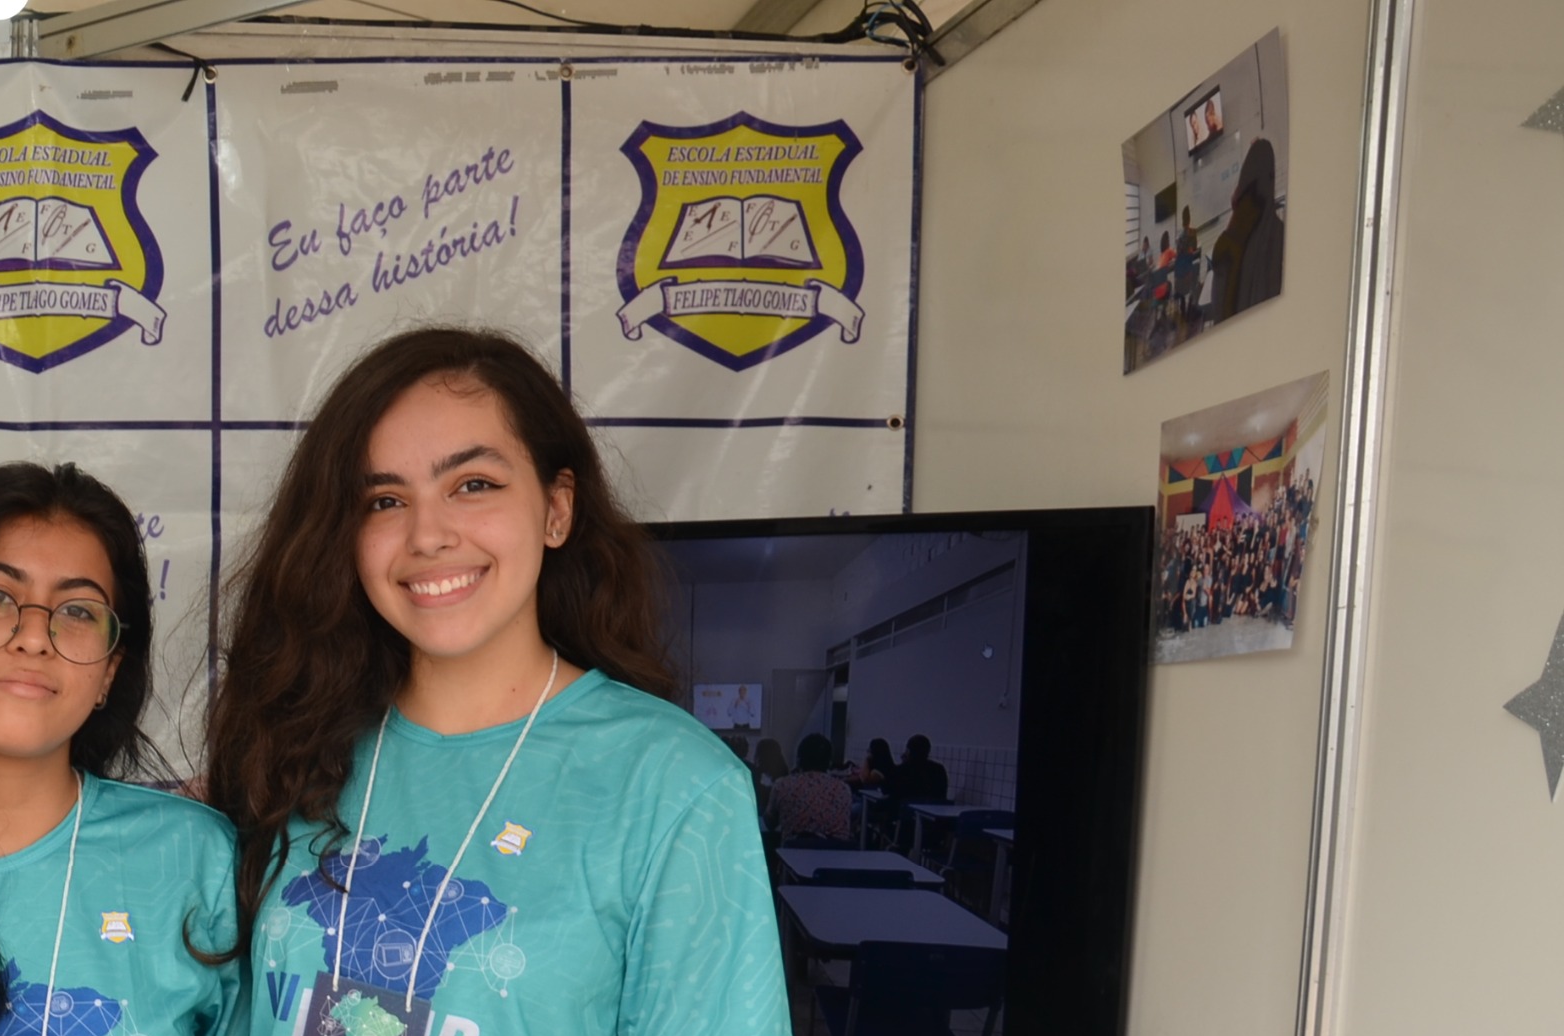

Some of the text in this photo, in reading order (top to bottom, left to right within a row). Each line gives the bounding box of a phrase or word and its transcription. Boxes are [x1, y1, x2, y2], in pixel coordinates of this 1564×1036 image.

[30, 145, 111, 167] ESTADUAL
[666, 145, 819, 163] ESCOLA ESTADUAL
[27, 169, 116, 190] FUNDAMENTAL
[662, 167, 823, 187] DE ENSINO FUNDAMENTAL
[268, 146, 514, 271] Eu faço parte
[264, 195, 519, 338] dessa história!
[59, 291, 108, 312] GOMES
[673, 290, 722, 311] FELIPE
[763, 290, 808, 312] GOMES
